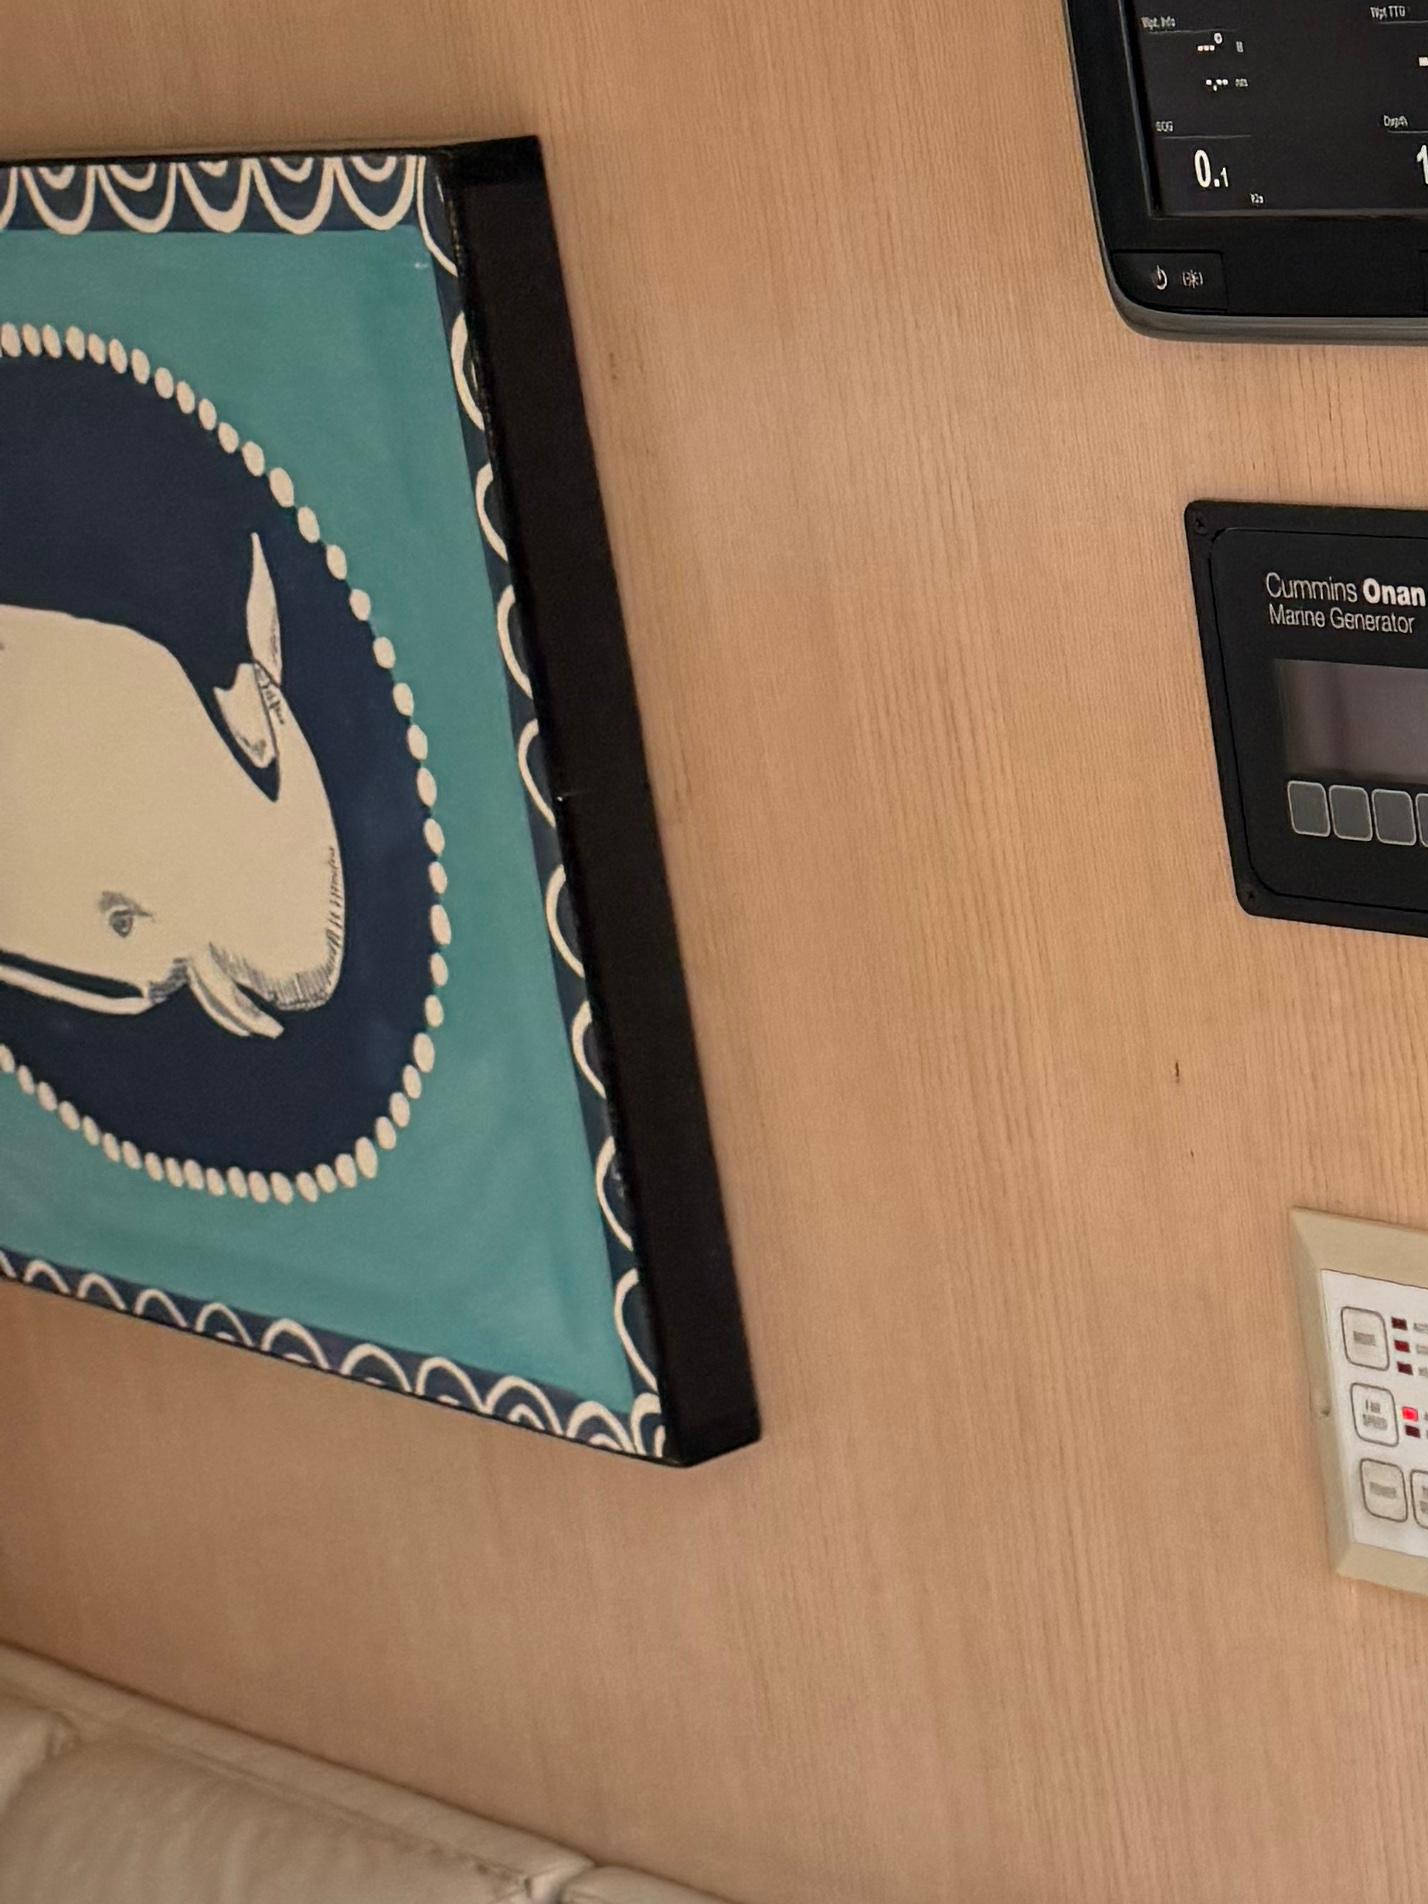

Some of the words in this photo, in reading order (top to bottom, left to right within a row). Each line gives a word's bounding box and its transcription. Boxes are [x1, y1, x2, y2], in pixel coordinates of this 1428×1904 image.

[1194, 149, 1229, 188] 0.1
[1265, 571, 1358, 604] Cummins
[1362, 576, 1427, 608] Onan
[1268, 603, 1326, 629] Marine
[1330, 606, 1415, 635] Generator
